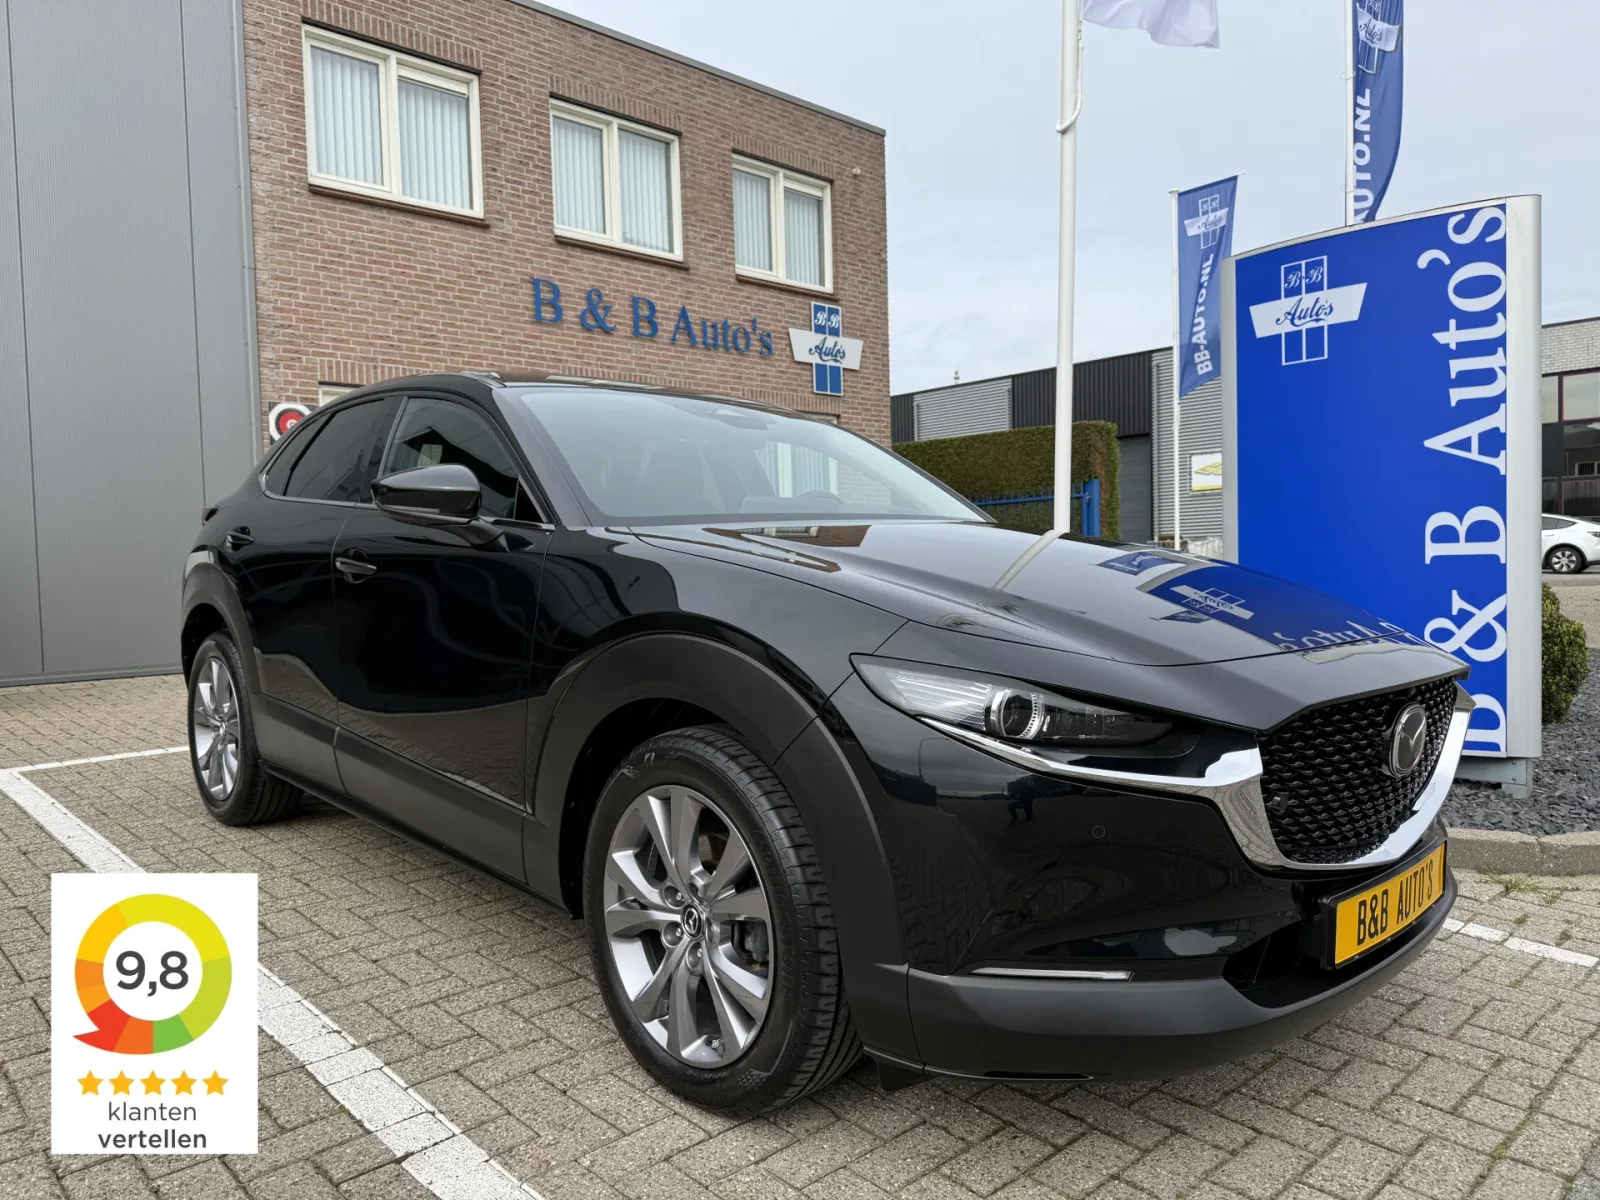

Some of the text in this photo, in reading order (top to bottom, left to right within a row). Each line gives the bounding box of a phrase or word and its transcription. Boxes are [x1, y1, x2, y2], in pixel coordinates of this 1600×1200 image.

[532, 277, 774, 357] B & B Auto's
[808, 336, 846, 364] Auto's
[1191, 253, 1214, 376] BB-AUTO.NL
[1275, 297, 1334, 327] Auto's
[1417, 206, 1507, 475] Auto's
[1424, 505, 1507, 565] B
[1424, 589, 1507, 662] &
[1357, 858, 1434, 946] B&B AUTO'S
